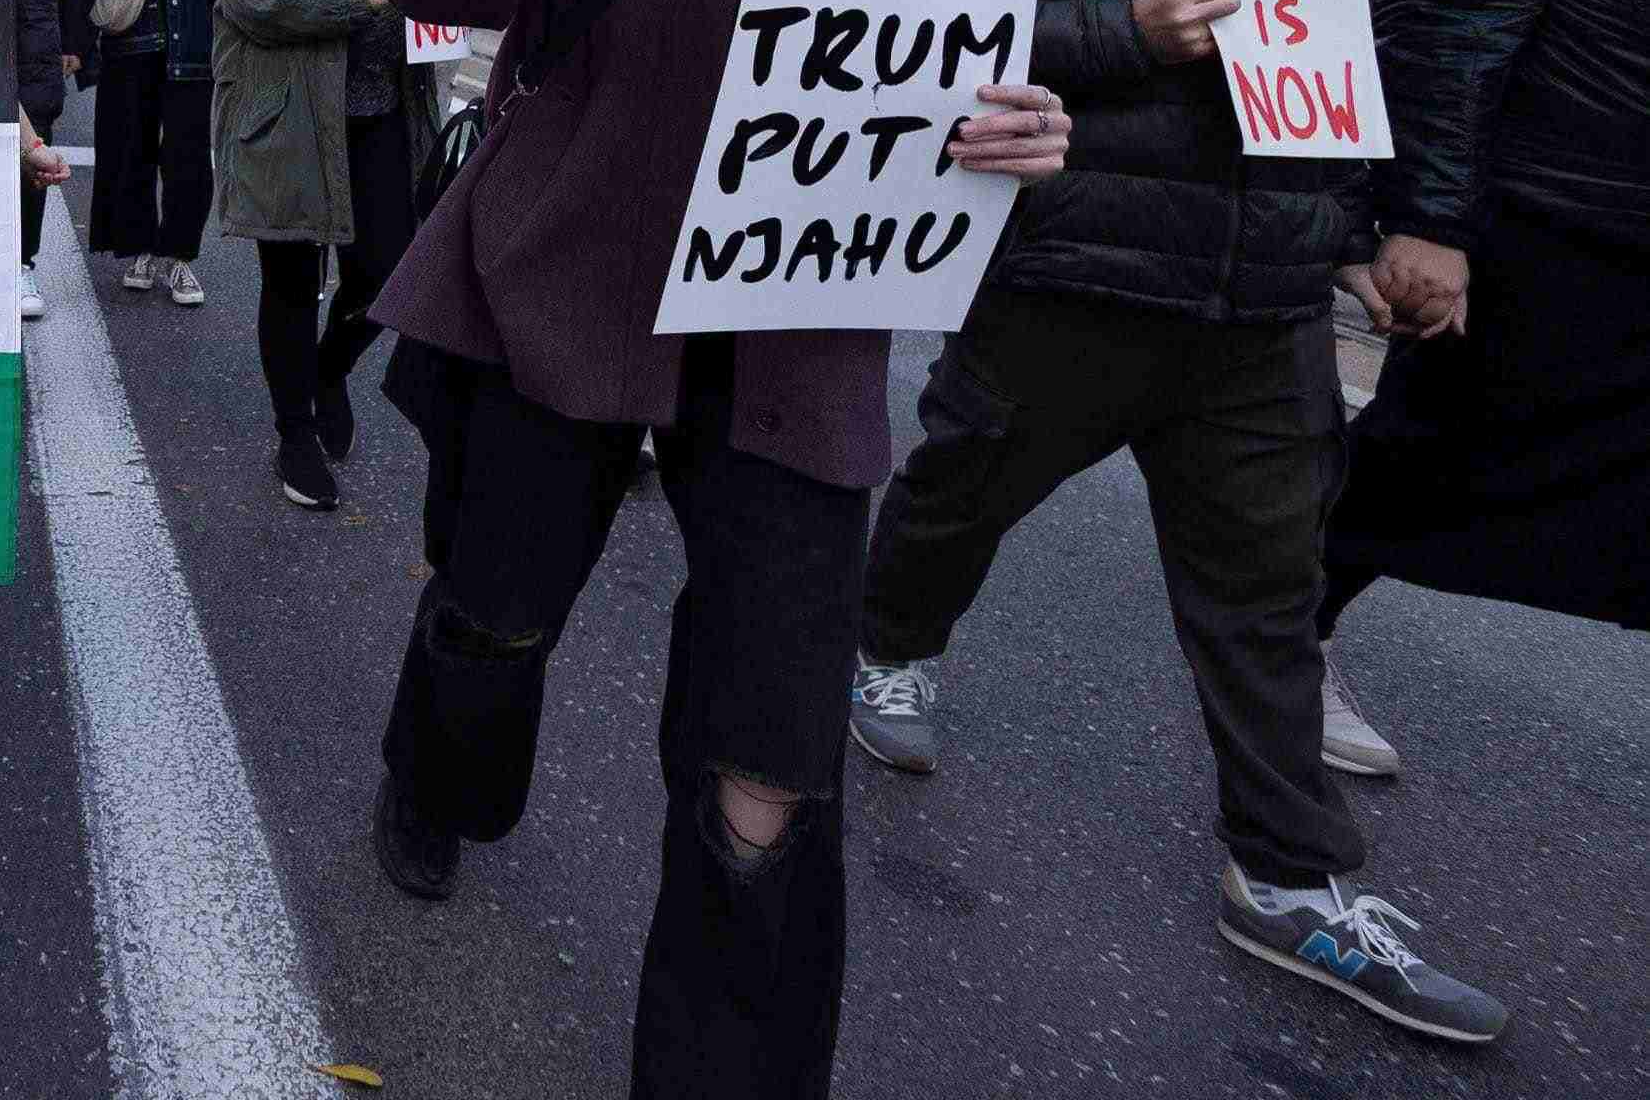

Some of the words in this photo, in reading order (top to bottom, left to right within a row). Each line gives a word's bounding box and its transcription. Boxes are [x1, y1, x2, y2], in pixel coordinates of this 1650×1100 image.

[740, 7, 1015, 92] TRUM
[1233, 61, 1360, 143] NOW
[683, 212, 971, 283] NJAHU
